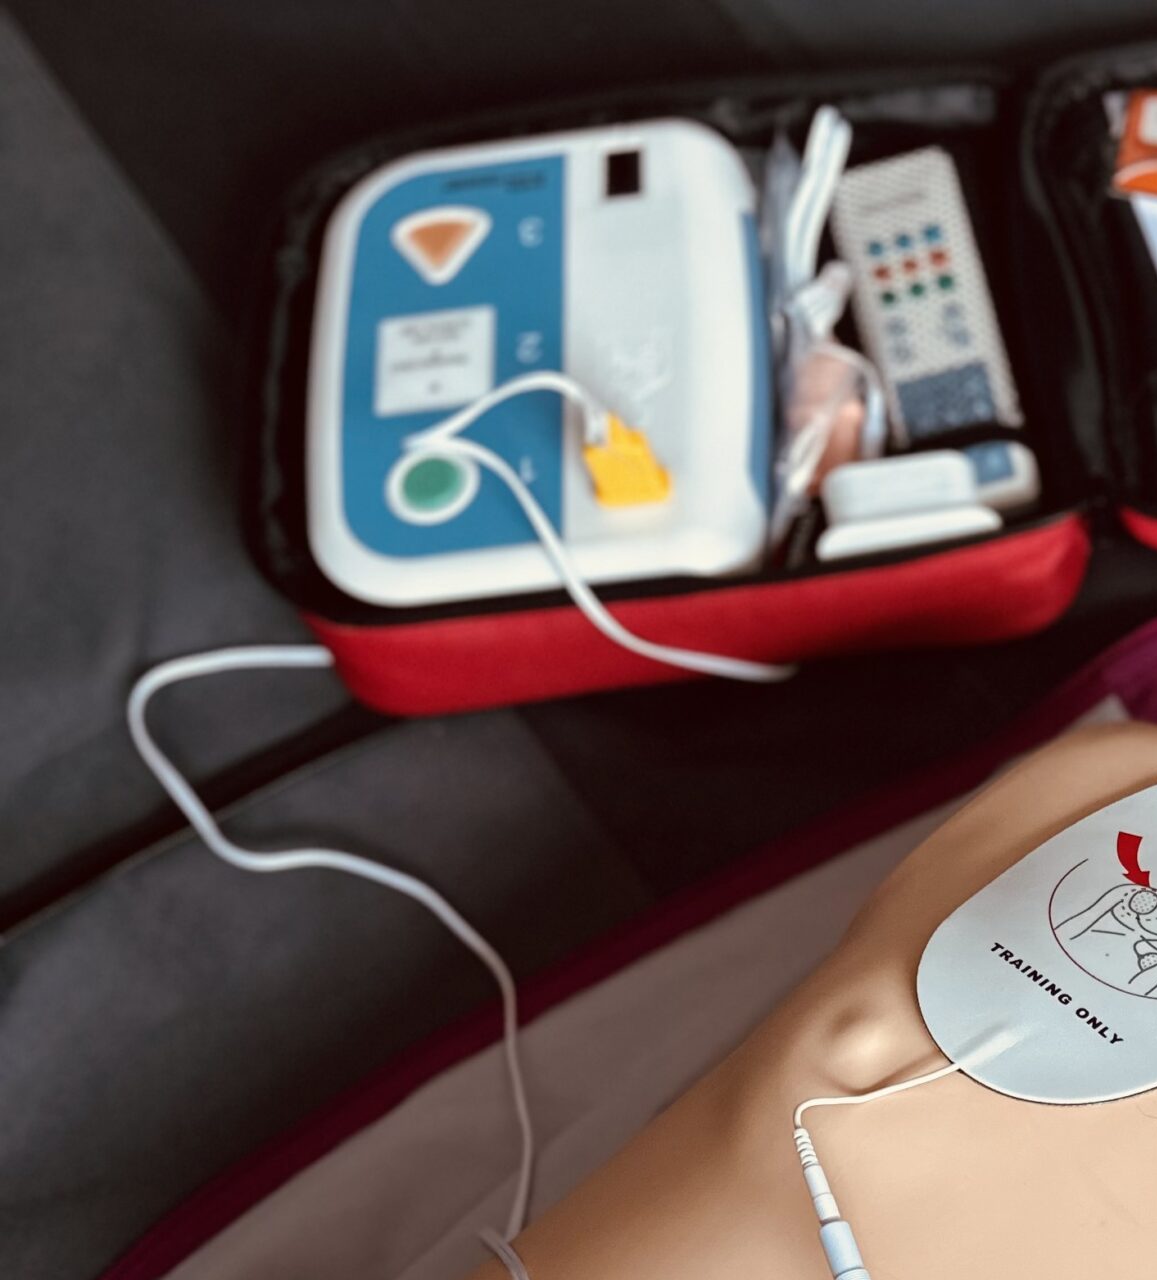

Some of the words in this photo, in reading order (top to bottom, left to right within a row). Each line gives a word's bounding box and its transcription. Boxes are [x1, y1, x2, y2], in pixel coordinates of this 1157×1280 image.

[517, 215, 544, 248] 3
[515, 330, 543, 363] 2
[990, 942, 1073, 1006] TRAINING
[1075, 1007, 1124, 1045] ONLY
